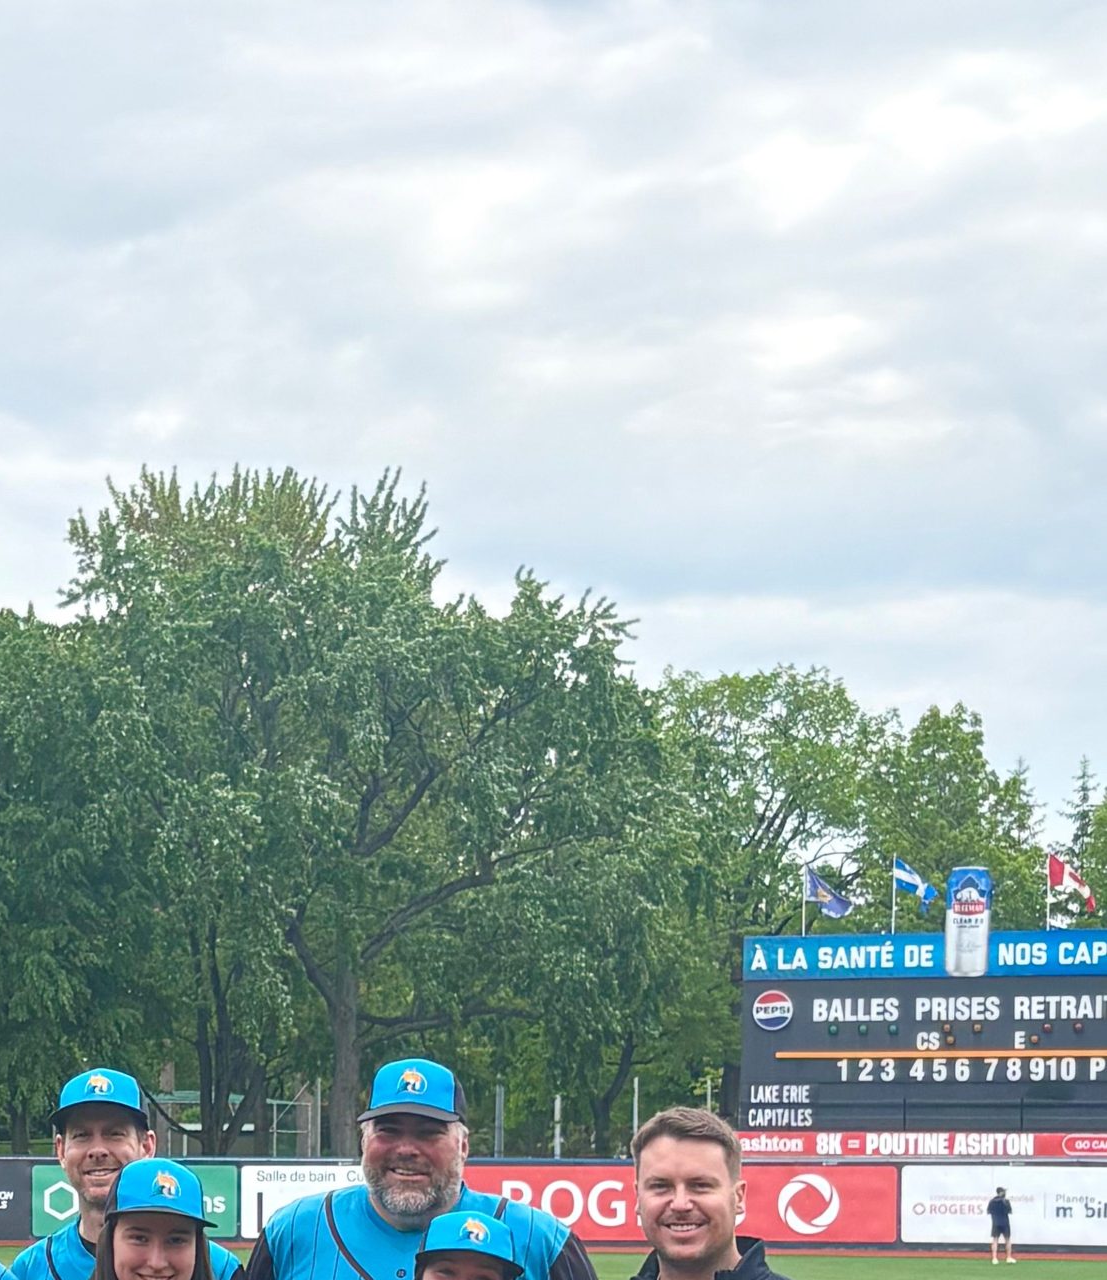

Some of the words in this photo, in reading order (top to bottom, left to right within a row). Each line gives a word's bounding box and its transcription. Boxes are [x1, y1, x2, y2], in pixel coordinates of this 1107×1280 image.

[750, 944, 767, 971] À
[778, 947, 808, 970] LA
[818, 940, 894, 969] SANTÉ
[904, 945, 934, 967] DE
[998, 943, 1047, 966] NOS
[755, 1006, 791, 1015] PEPSI
[812, 998, 899, 1022] BALLES
[915, 996, 1000, 1021] PRISES
[916, 1031, 940, 1050] CS
[1014, 1031, 1026, 1049] E
[750, 1085, 780, 1103] LAKE
[782, 1085, 810, 1103] ERIE
[748, 1108, 812, 1127] CAPITALES
[740, 1133, 804, 1152] ashton
[816, 1132, 843, 1155] 8K
[865, 1133, 949, 1155] POUTINE
[953, 1133, 1034, 1155] ASHTON
[1075, 1140, 1090, 1149] GO
[256, 1170, 287, 1182] Salle
[290, 1170, 305, 1182] de
[309, 1170, 336, 1182] bain
[501, 1180, 633, 1227] ROG
[929, 1204, 983, 1215] ROGERS
